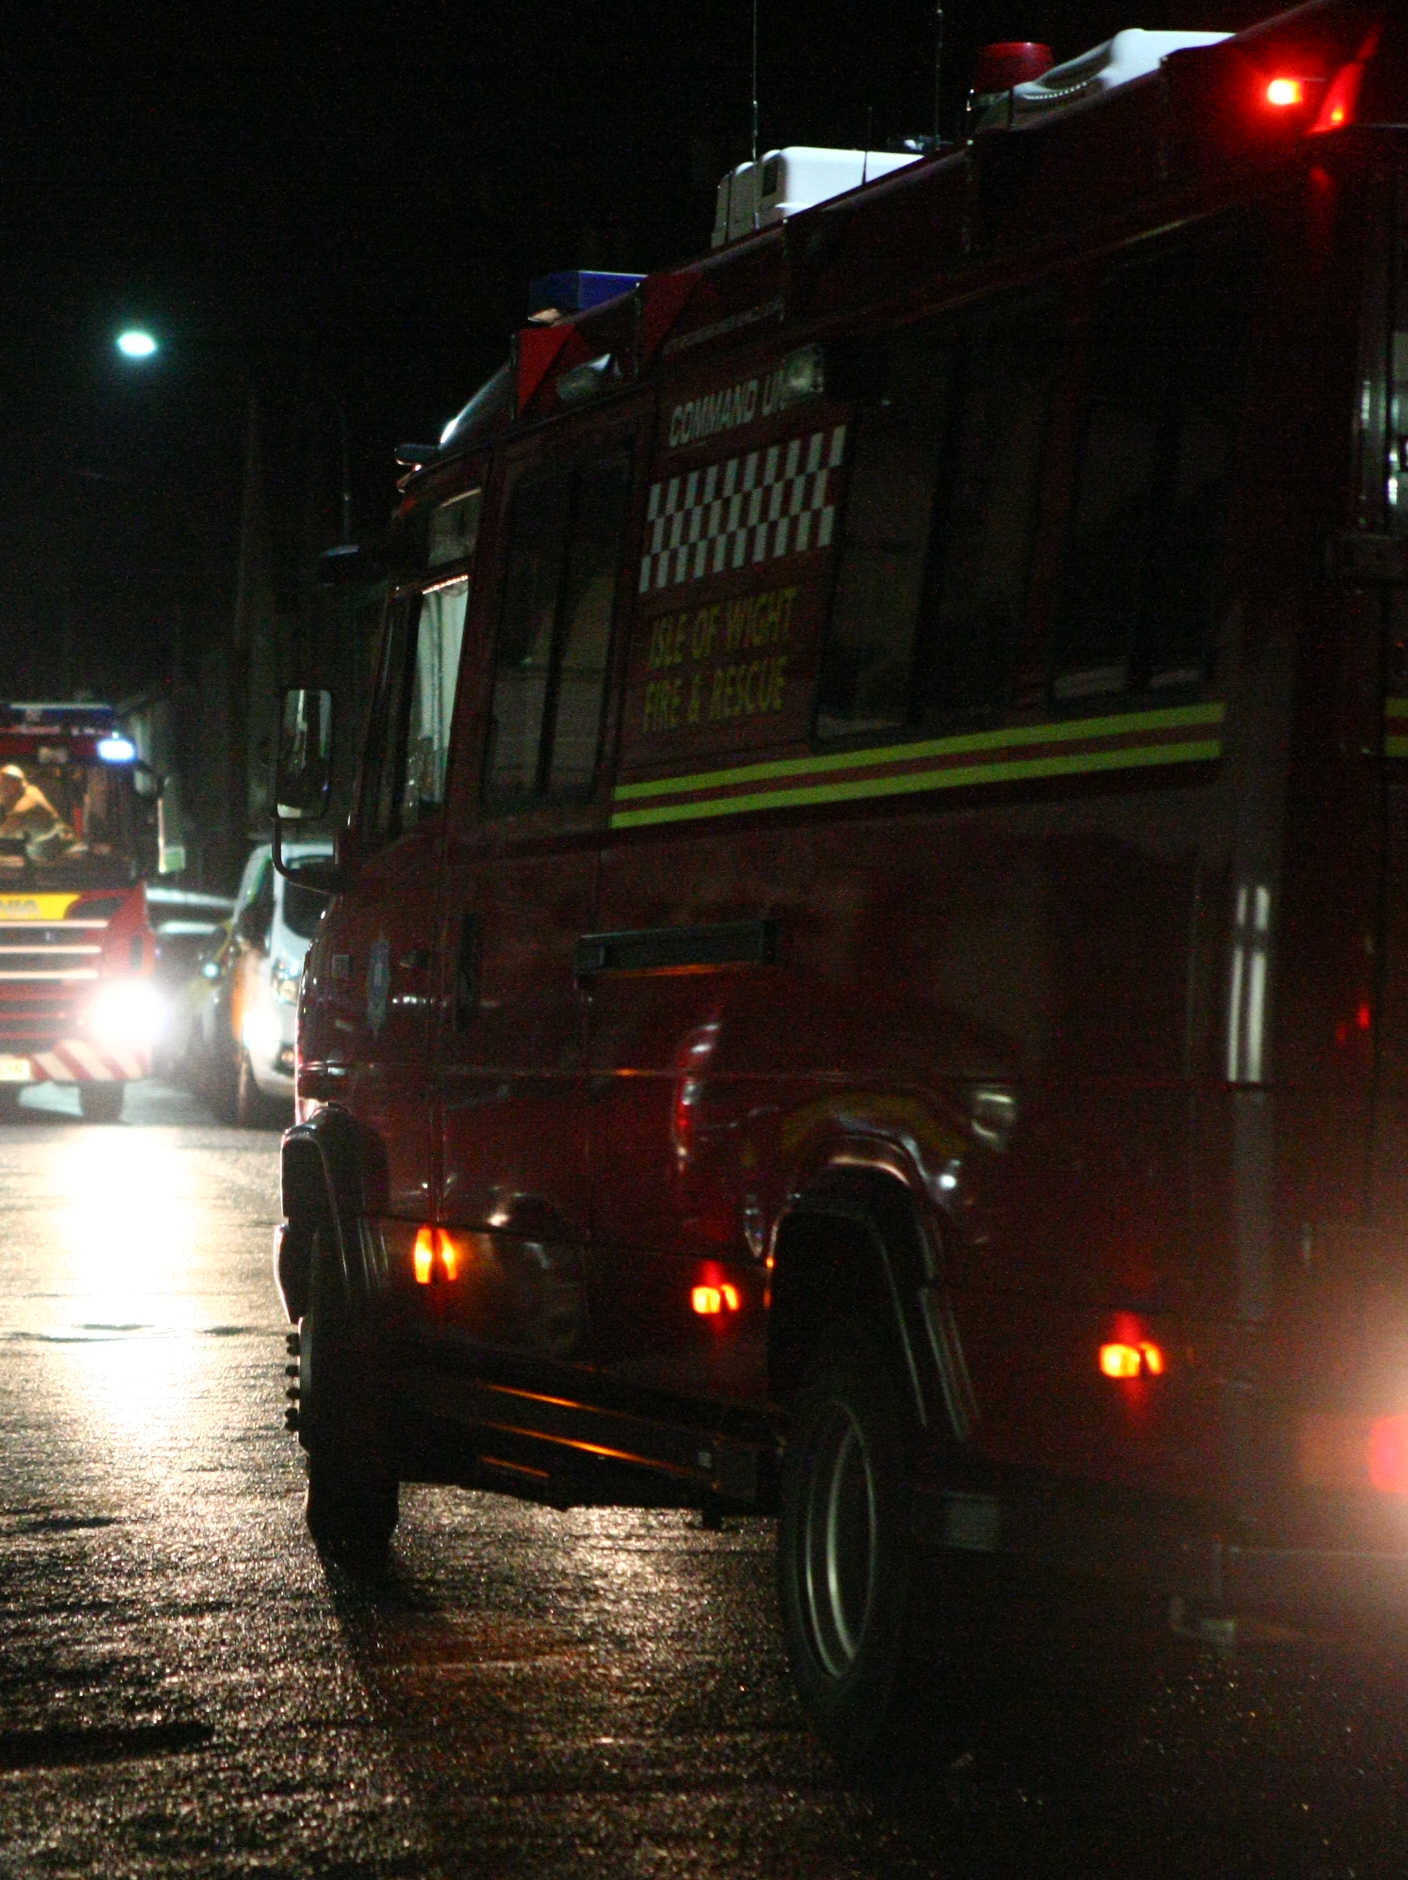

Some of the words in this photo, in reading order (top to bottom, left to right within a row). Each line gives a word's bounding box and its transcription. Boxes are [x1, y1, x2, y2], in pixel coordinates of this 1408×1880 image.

[669, 379, 759, 448] COMMAND
[650, 614, 688, 668] ISLE
[692, 604, 719, 659] OF
[726, 586, 797, 650] WIGHT
[644, 678, 682, 732] FIRE
[688, 672, 704, 723] &
[709, 656, 788, 722] RESCUE
